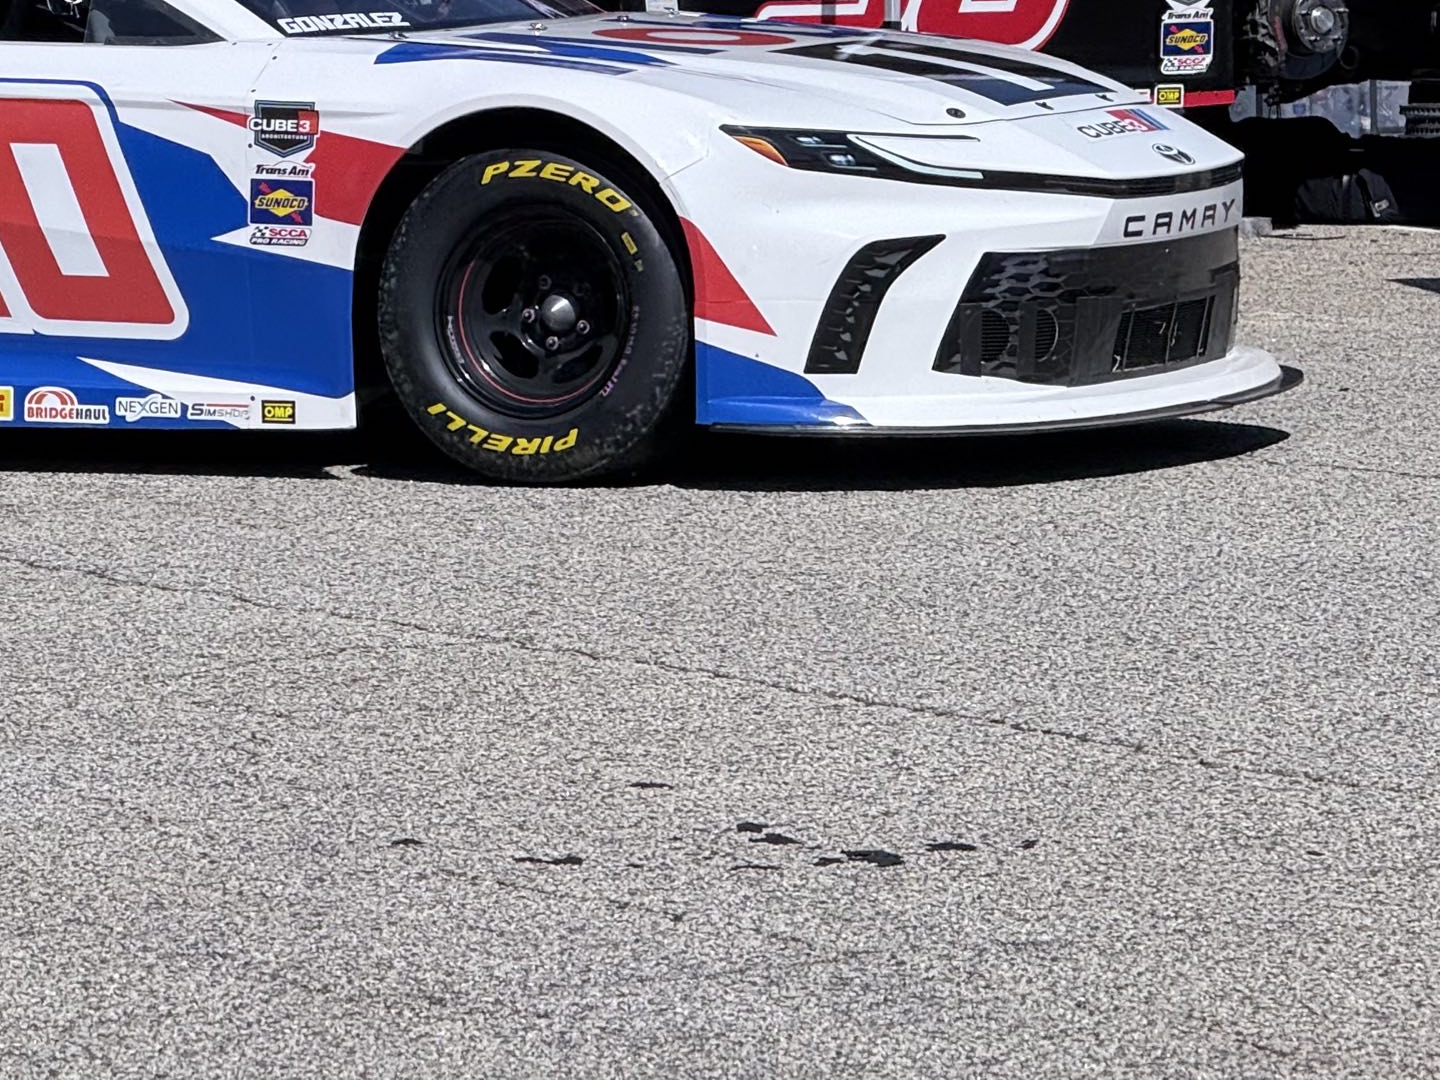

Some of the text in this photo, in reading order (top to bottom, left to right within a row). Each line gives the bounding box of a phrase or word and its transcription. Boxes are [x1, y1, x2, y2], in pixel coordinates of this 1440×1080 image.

[276, 11, 411, 34] GONZALEZ
[1167, 34, 1207, 44] SUNOCO
[1158, 91, 1180, 101] OMP
[255, 164, 310, 177] Trans Am
[257, 196, 307, 210] SUNOCO
[268, 227, 308, 238] SCCA
[250, 237, 307, 246] PRO RACING
[26, 406, 108, 421] BRIDGEHAUL
[117, 399, 179, 416] NEXGEN
[263, 406, 293, 418] OMP
[426, 402, 579, 456] PIRELLI
